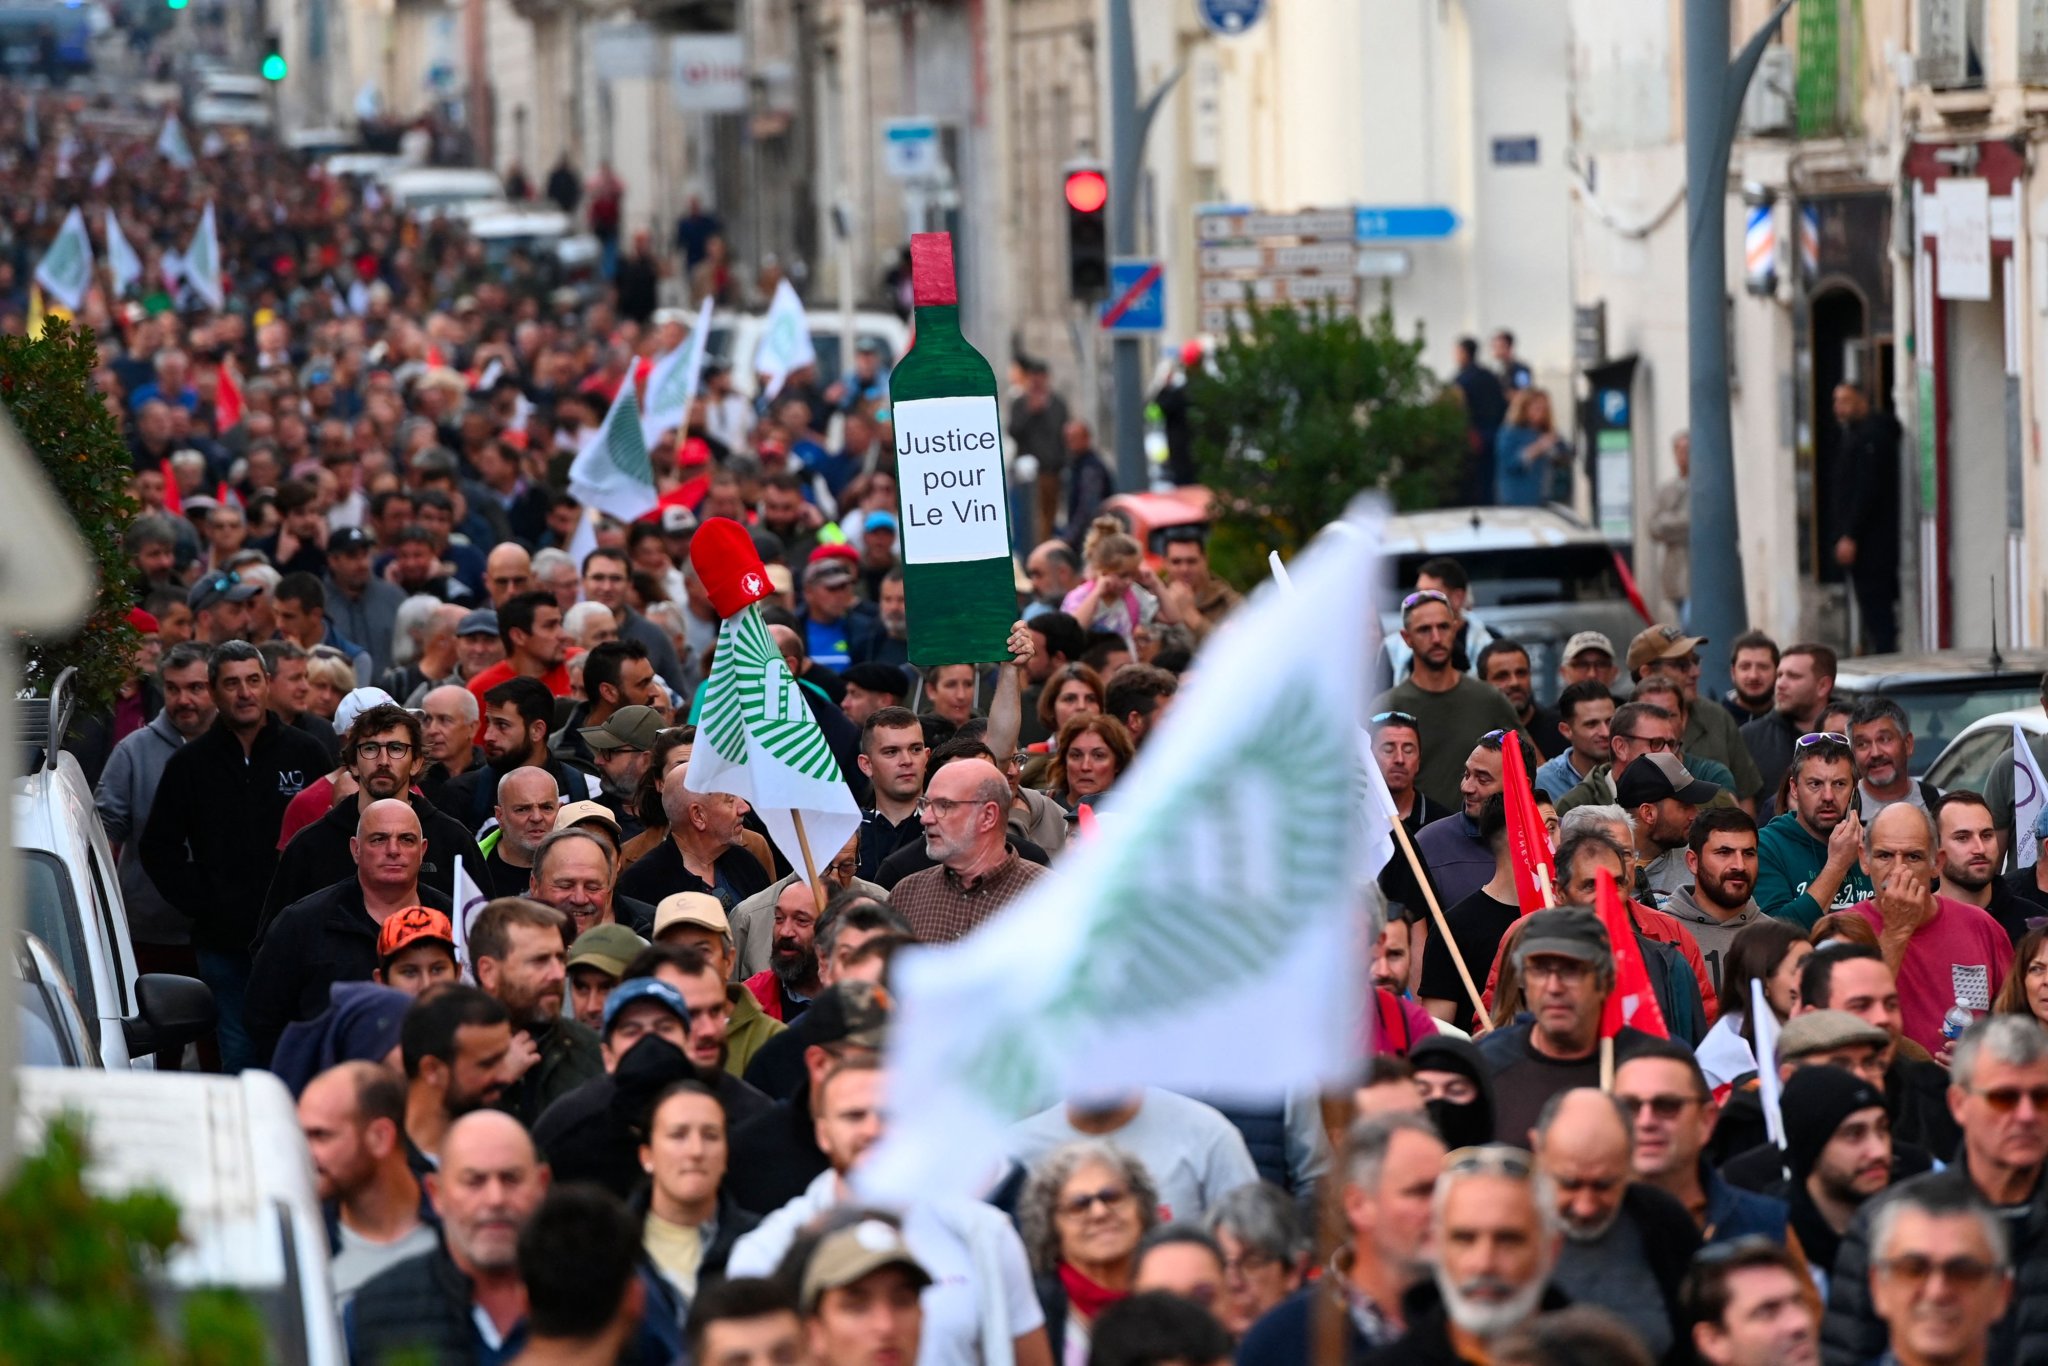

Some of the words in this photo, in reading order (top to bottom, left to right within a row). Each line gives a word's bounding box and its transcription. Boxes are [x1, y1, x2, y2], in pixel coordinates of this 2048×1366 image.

[899, 428, 995, 455] Justice
[923, 468, 985, 495] pour
[909, 504, 943, 527] Le
[952, 499, 997, 523] Vin
